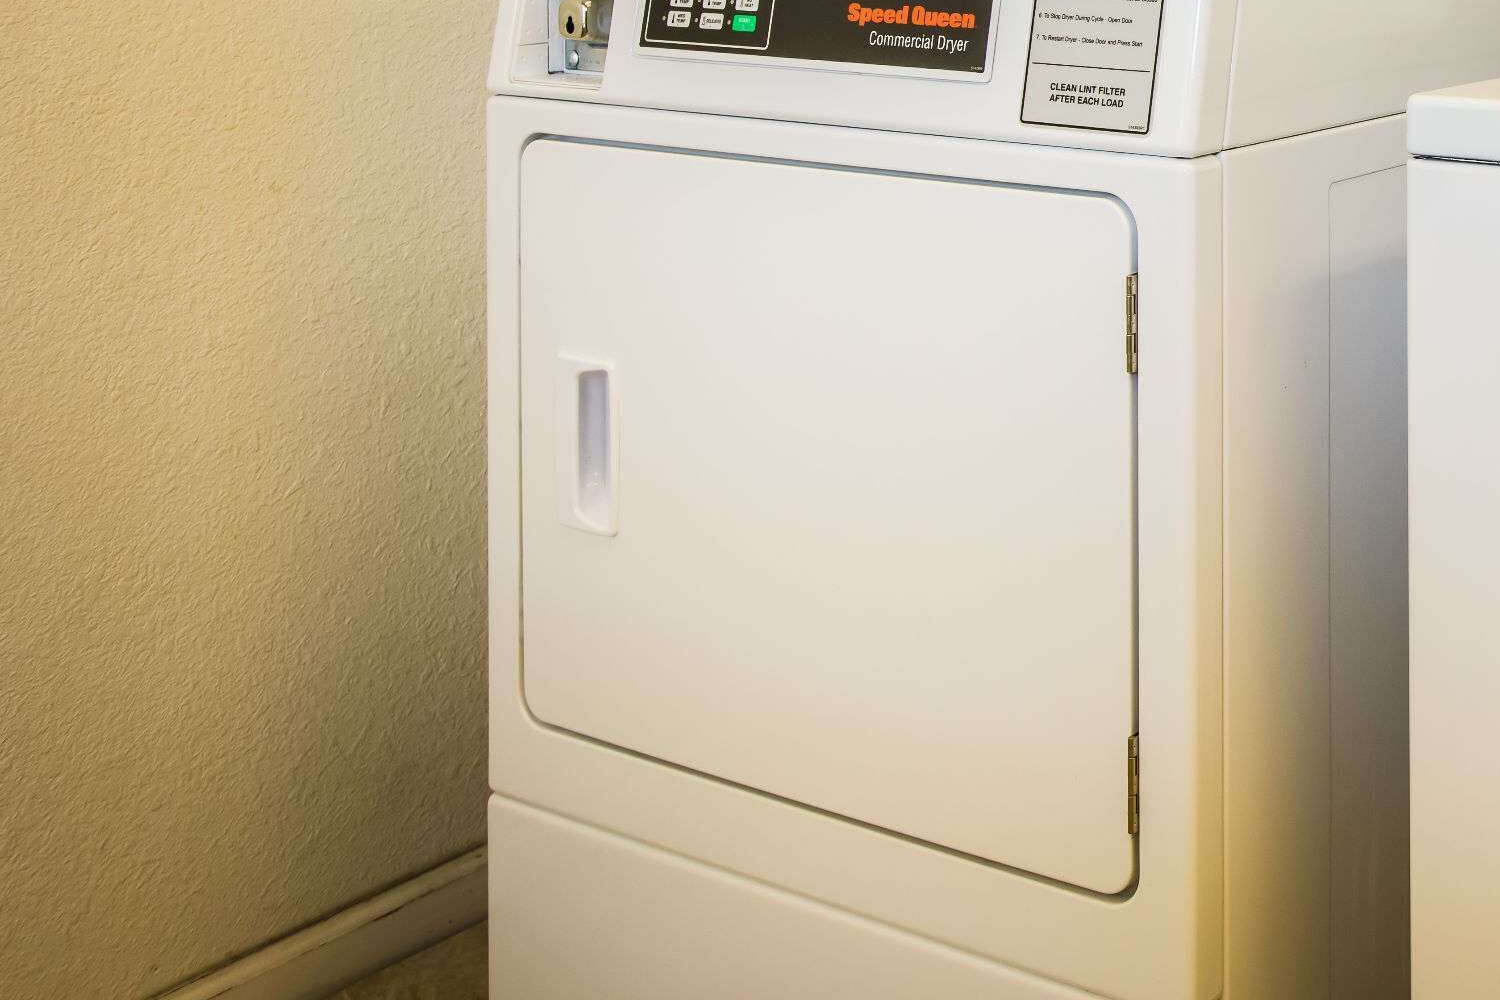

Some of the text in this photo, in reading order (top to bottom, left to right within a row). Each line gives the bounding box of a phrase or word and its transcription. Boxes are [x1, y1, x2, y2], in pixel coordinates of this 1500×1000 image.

[847, 2, 976, 29] Speed Queen
[869, 30, 970, 54] Commercial Dryer
[1049, 82, 1126, 97] CLEAN LINT FILTER
[1048, 93, 1124, 108] AFTER EACH LOAD
